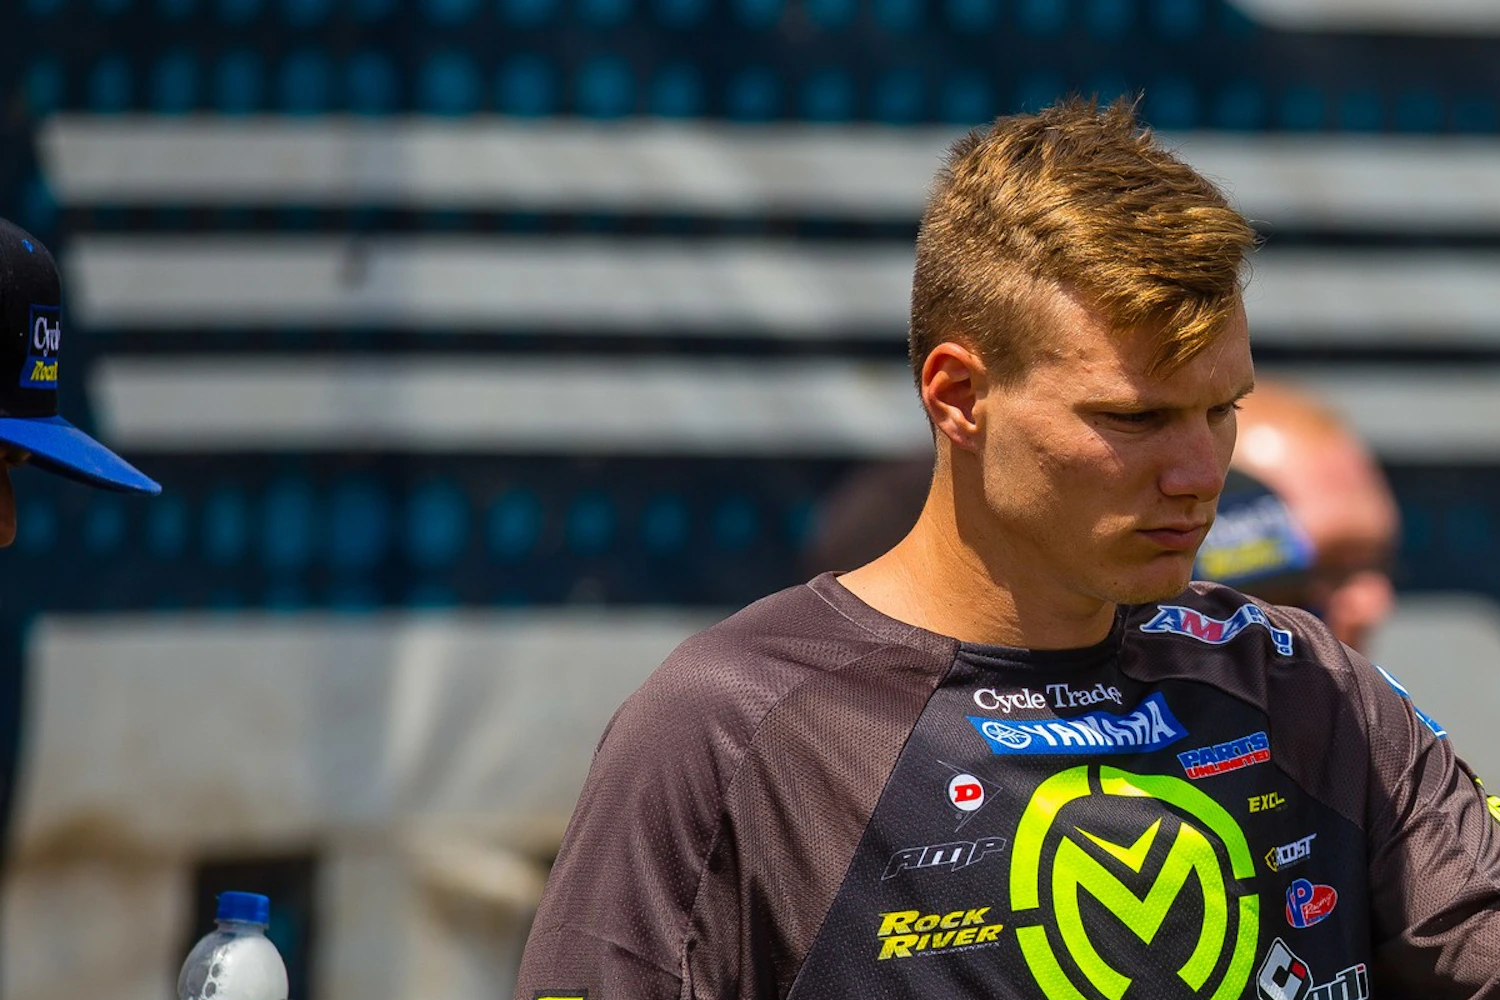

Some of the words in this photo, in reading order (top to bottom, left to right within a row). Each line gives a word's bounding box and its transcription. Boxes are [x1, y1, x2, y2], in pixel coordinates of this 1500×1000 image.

[973, 688, 1046, 713] Cycle
[1023, 701, 1177, 746] YAMAHA
[1177, 731, 1270, 768] PARTS
[1185, 749, 1271, 780] UNLIMITED
[877, 906, 991, 936] ROCK
[877, 924, 1004, 960] RIVER
